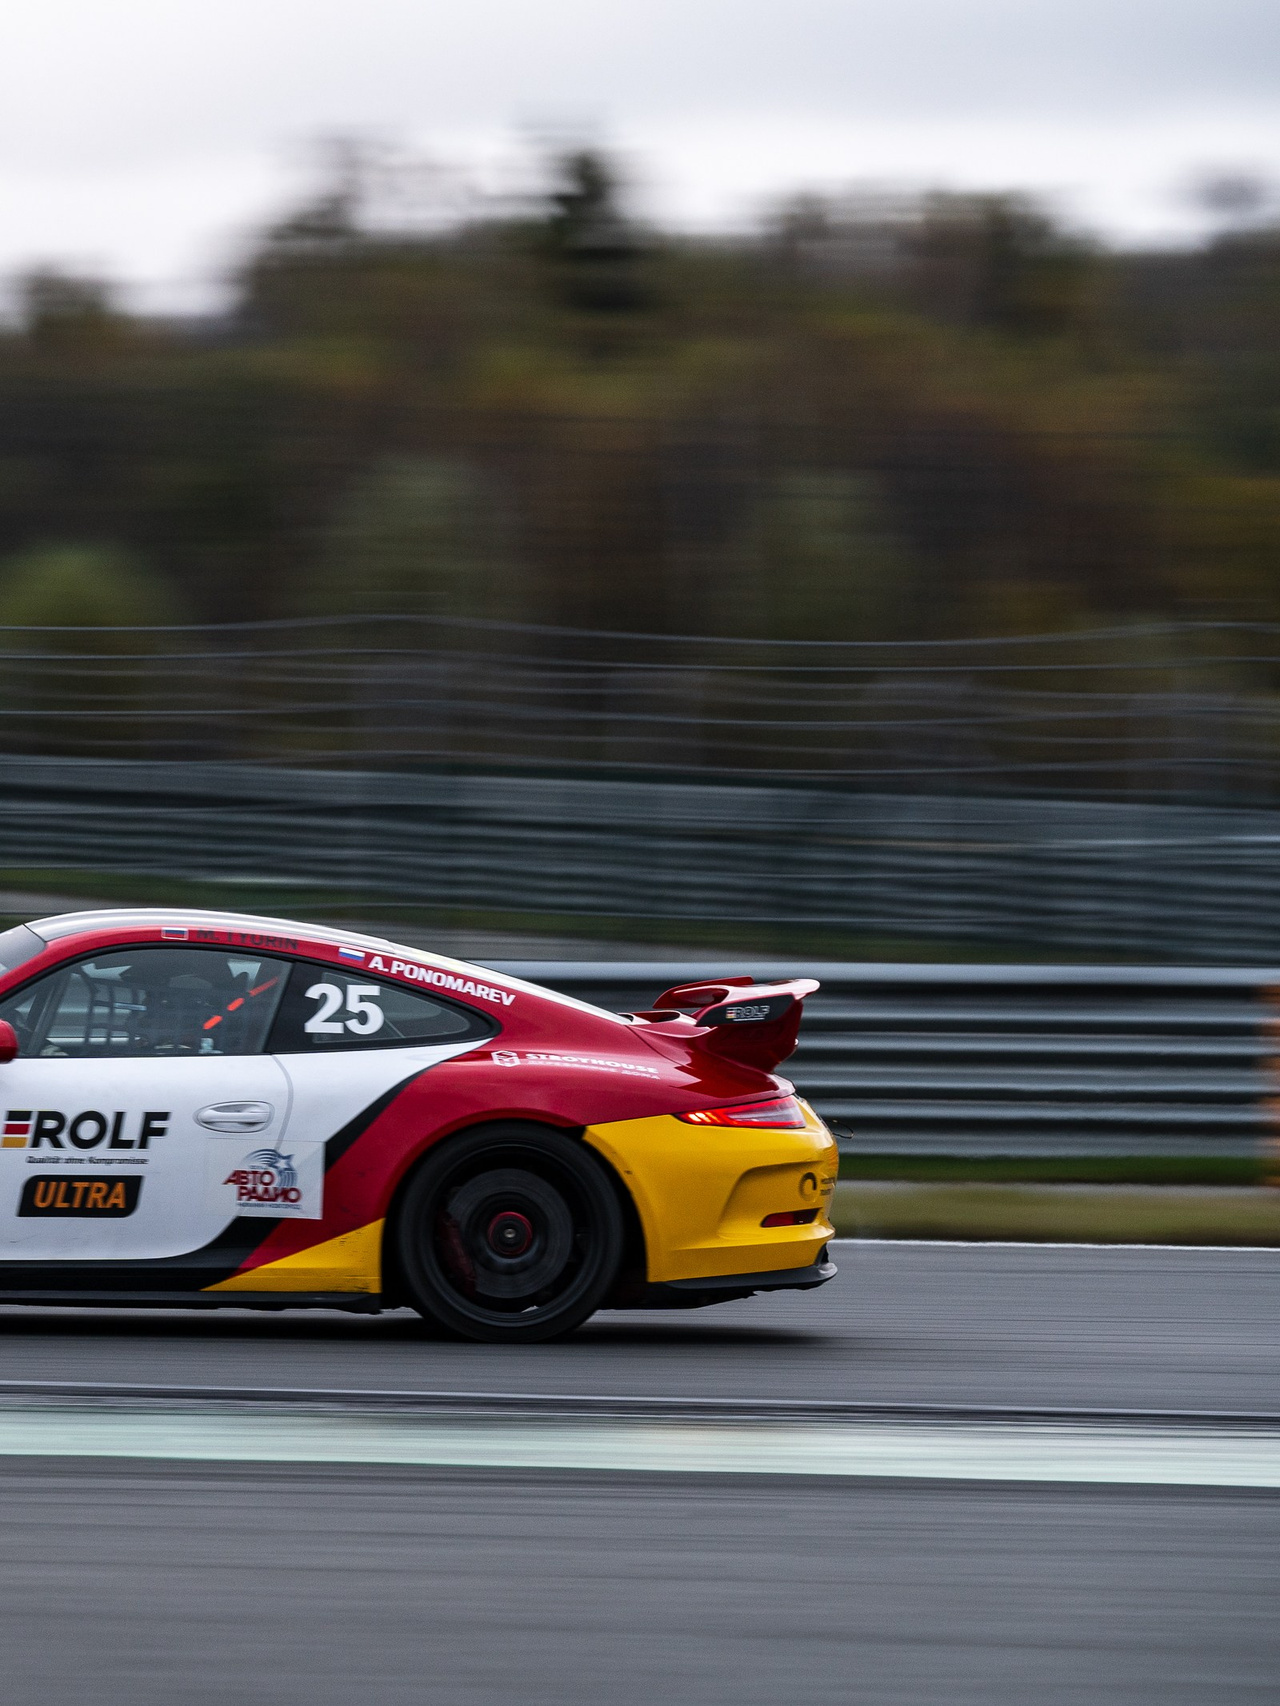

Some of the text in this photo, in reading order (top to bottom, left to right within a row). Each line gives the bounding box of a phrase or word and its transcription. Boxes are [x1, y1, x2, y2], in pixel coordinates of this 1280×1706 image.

[304, 983, 385, 1035] 25
[525, 1053, 660, 1074] STROYHOUSE
[30, 1110, 173, 1150] ROLF
[222, 1169, 276, 1187] АВТО
[32, 1181, 127, 1209] ULTRA
[236, 1186, 303, 1204] РАДИО
